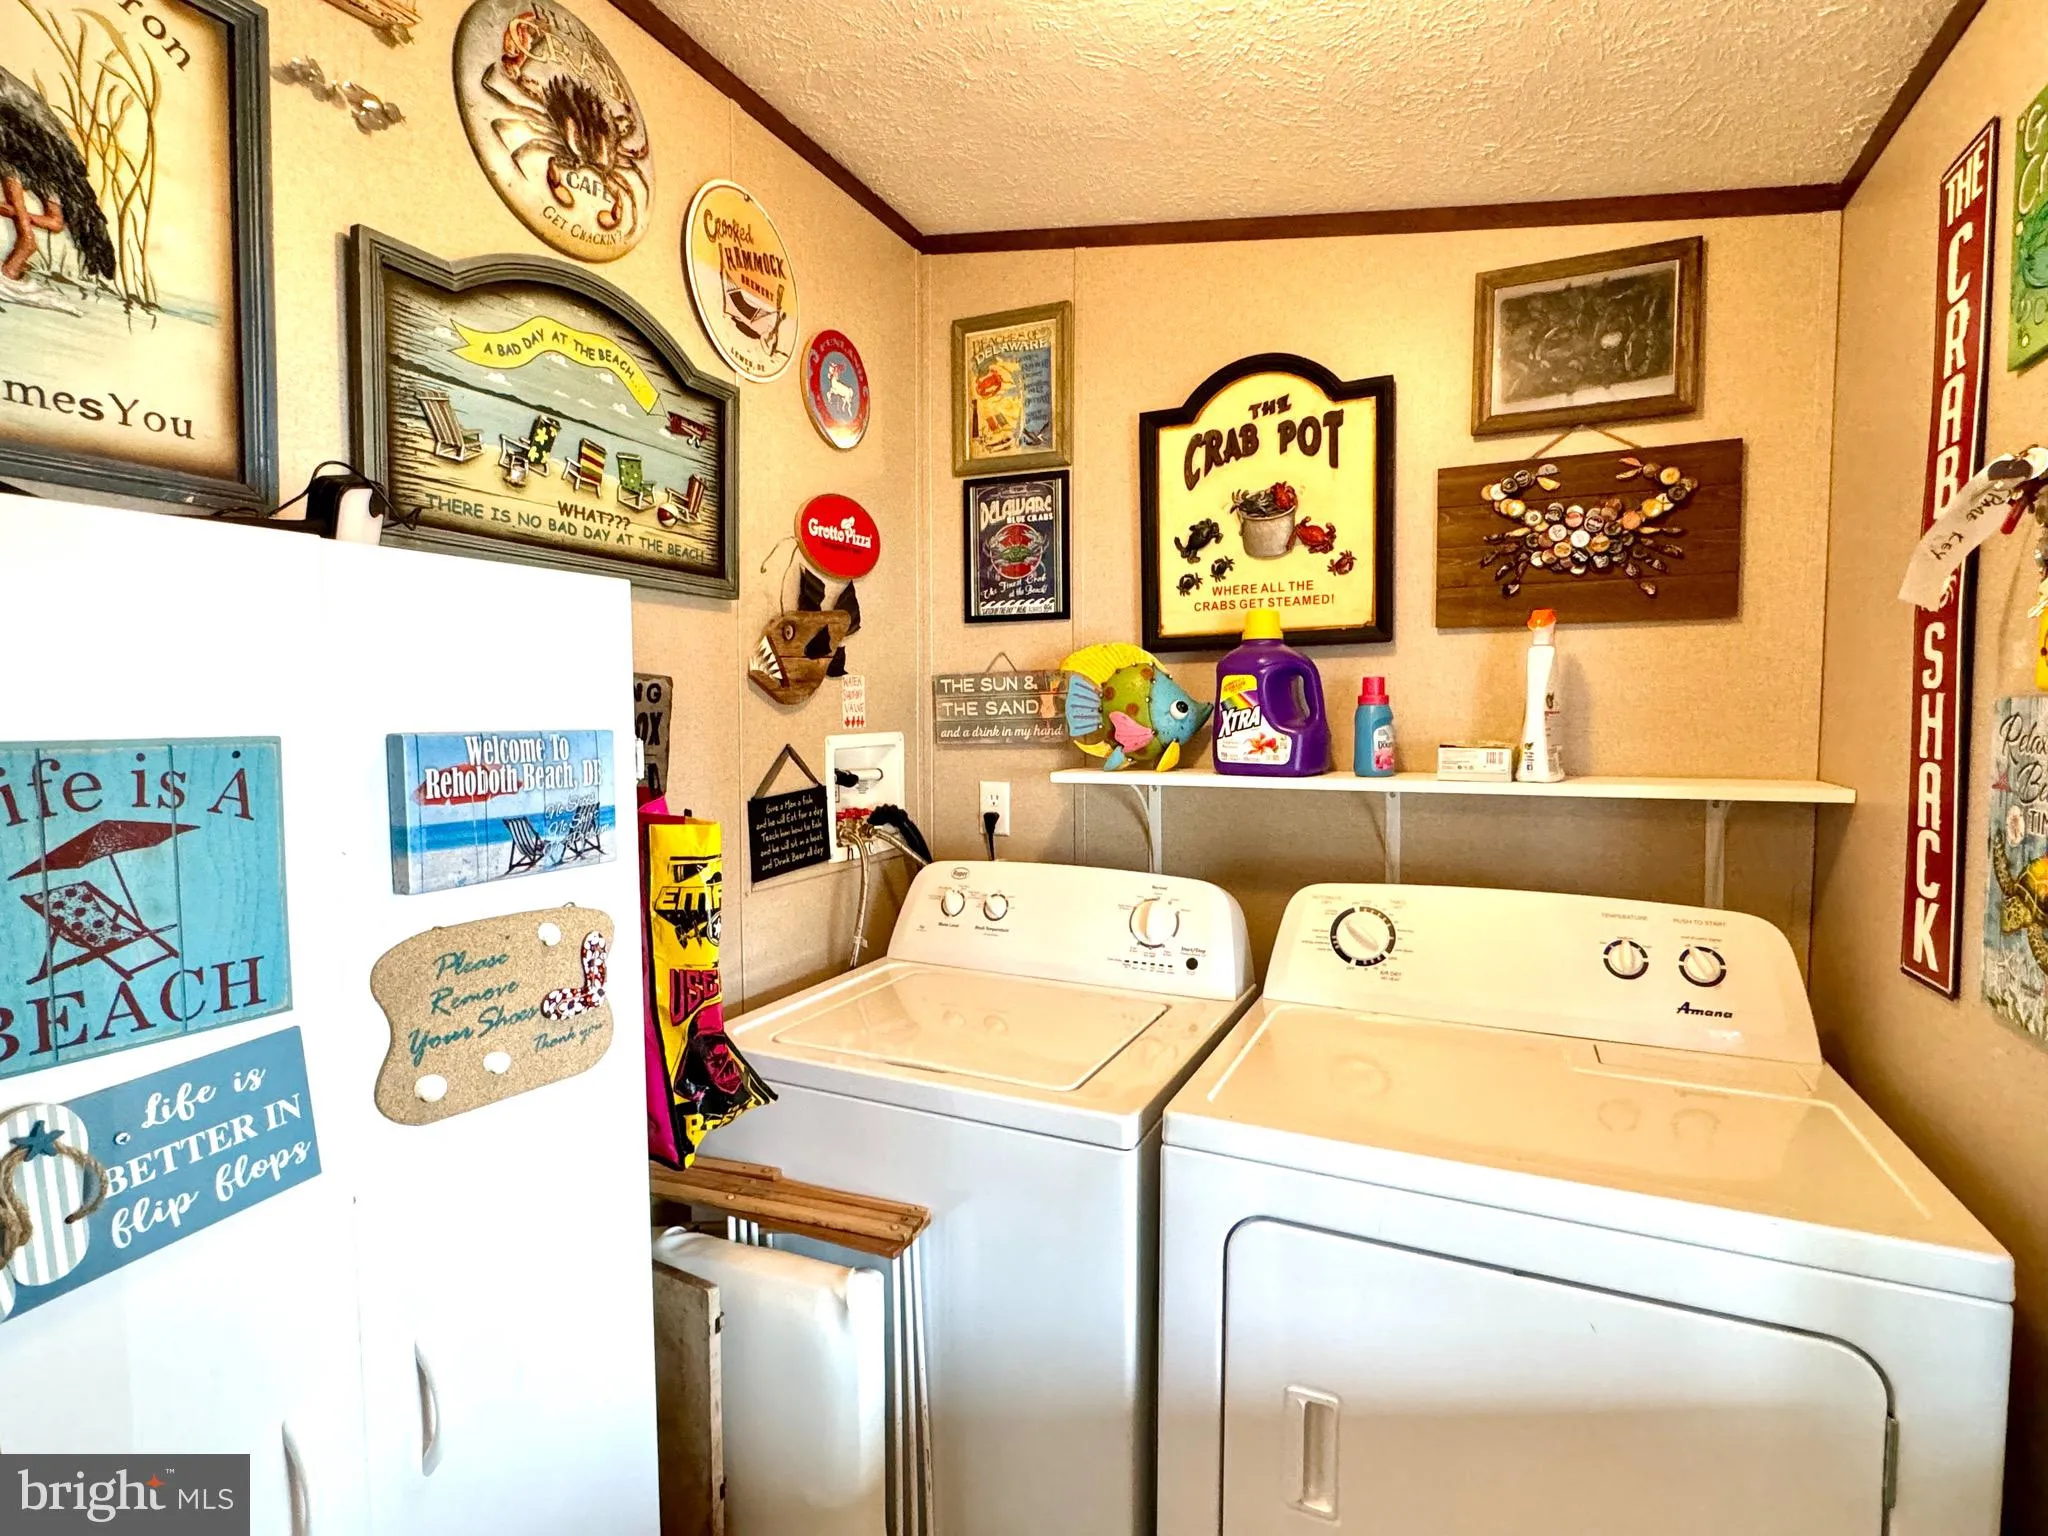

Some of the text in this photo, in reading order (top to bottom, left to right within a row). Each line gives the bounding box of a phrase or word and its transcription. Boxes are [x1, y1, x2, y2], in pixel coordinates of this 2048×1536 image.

[566, 171, 612, 203] CAFE
[543, 206, 569, 230] GET
[703, 209, 755, 246] Crooked
[724, 247, 787, 280] HAMMOCK
[741, 274, 775, 302] BREWERY
[483, 343, 494, 355] A
[497, 343, 521, 357] BAD
[522, 328, 544, 350] DAY
[551, 331, 568, 345] AT
[573, 339, 596, 361] THE
[975, 338, 1049, 364] DELAWARE
[107, 392, 195, 441] You
[1248, 394, 1292, 420] THE
[1184, 409, 1345, 491] CRAB POT
[425, 492, 705, 562] THERE IS NO BAD DAY AT THE BEACH
[557, 501, 631, 531] WHAT???
[980, 495, 1052, 531] DELAWARE
[808, 518, 872, 549] Grotto Pizza
[1913, 140, 1985, 974] THE CRAB SHACK
[1193, 594, 1335, 612] CRABS GET STEAMED!
[1212, 580, 1314, 597] WHERE ALL THE
[940, 675, 1038, 693] THE SUN &
[941, 699, 1039, 716] THE SAND
[1217, 705, 1262, 740] XTRA
[940, 725, 961, 738] and
[963, 728, 971, 738] a
[971, 724, 1001, 738] drink
[1001, 725, 1014, 737] in
[1014, 726, 1032, 740] my
[464, 733, 570, 766] Welcome To
[130, 752, 187, 810] is
[206, 767, 255, 822] A
[424, 764, 519, 800] Rehoboth
[522, 761, 578, 793] Beach,
[432, 950, 510, 980] Please
[430, 980, 520, 1016] Remove
[1676, 1001, 1734, 1019] Amana
[408, 1005, 540, 1068] Your Shoes
[533, 1022, 604, 1053] Thank you
[141, 1066, 266, 1129] Life is
[105, 1093, 302, 1199] BETTER IN
[111, 1140, 311, 1250] flip flops
